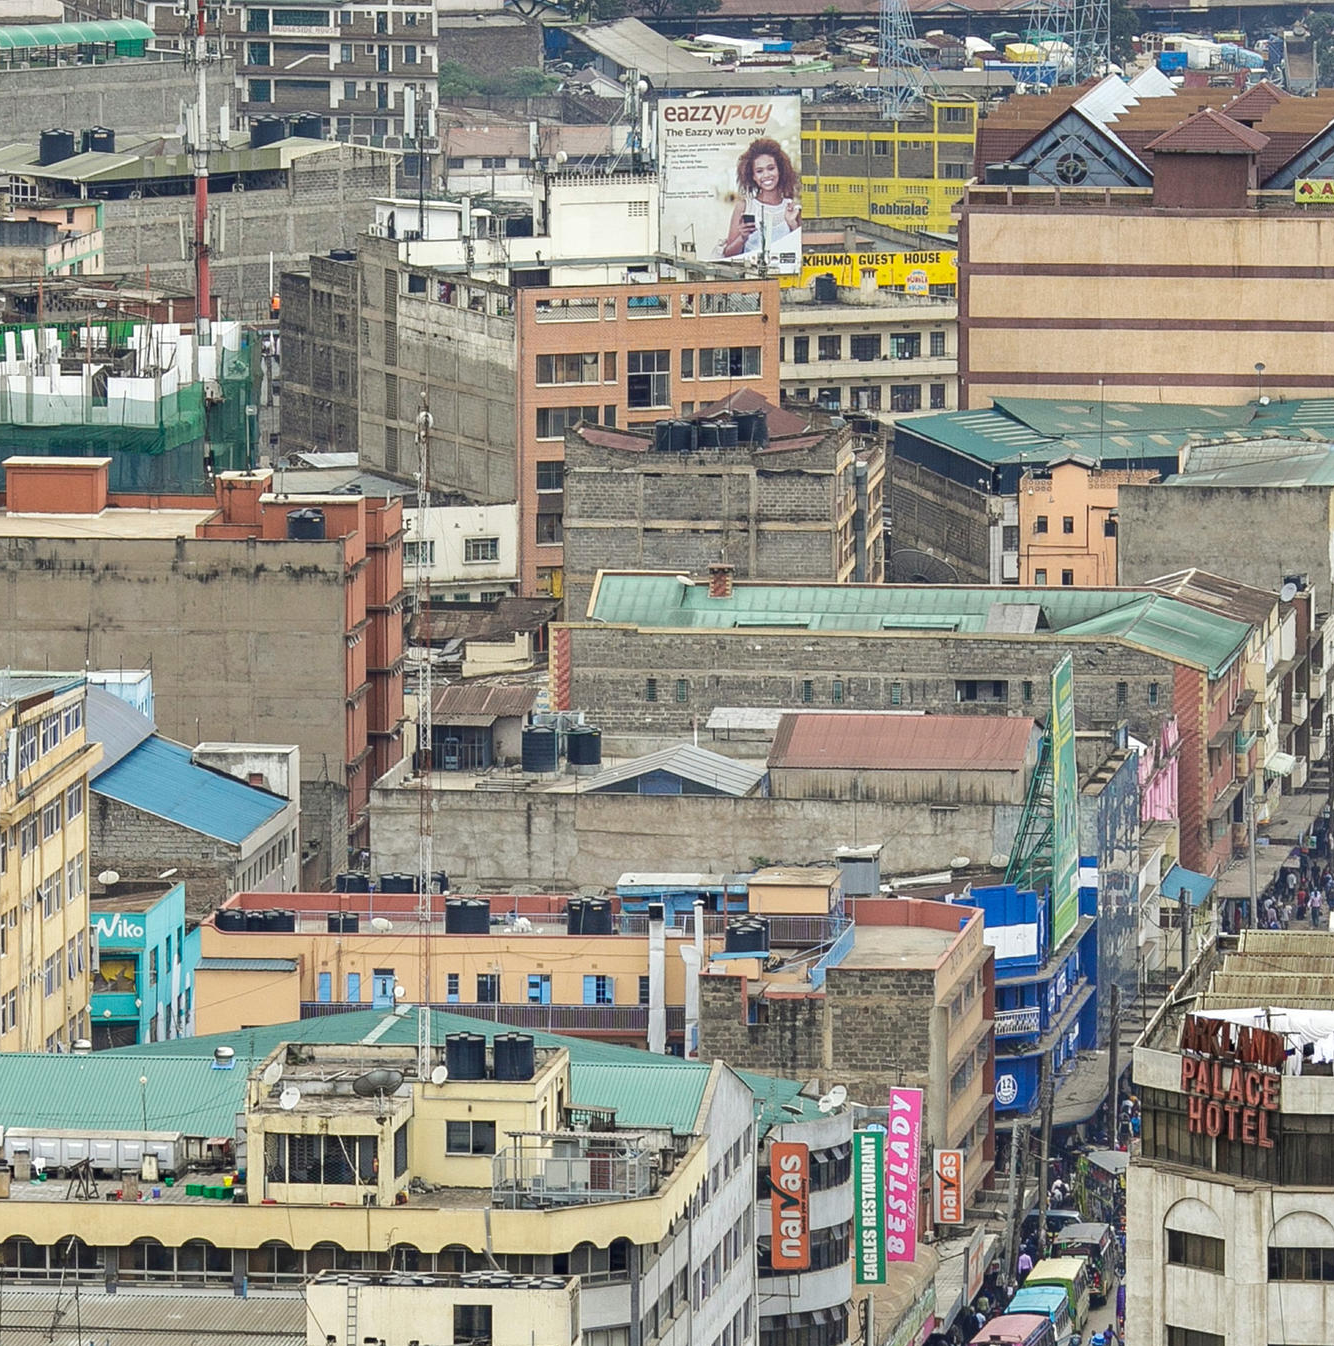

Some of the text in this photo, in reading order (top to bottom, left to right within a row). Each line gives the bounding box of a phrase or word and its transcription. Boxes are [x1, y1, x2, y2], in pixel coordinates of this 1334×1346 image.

[664, 103, 773, 126] eazzypay
[665, 127, 766, 138] The Eazzy way to pay
[870, 202, 929, 216] Robbialac
[802, 252, 941, 267] KIHUMO GUEST HOUSE
[1181, 1056, 1281, 1111] PALACE
[1188, 1096, 1274, 1148] HOTEL
[774, 1152, 803, 1259] naivas
[860, 1135, 879, 1281] EAGLES RESTAURANT
[937, 1153, 957, 1221] naivas
